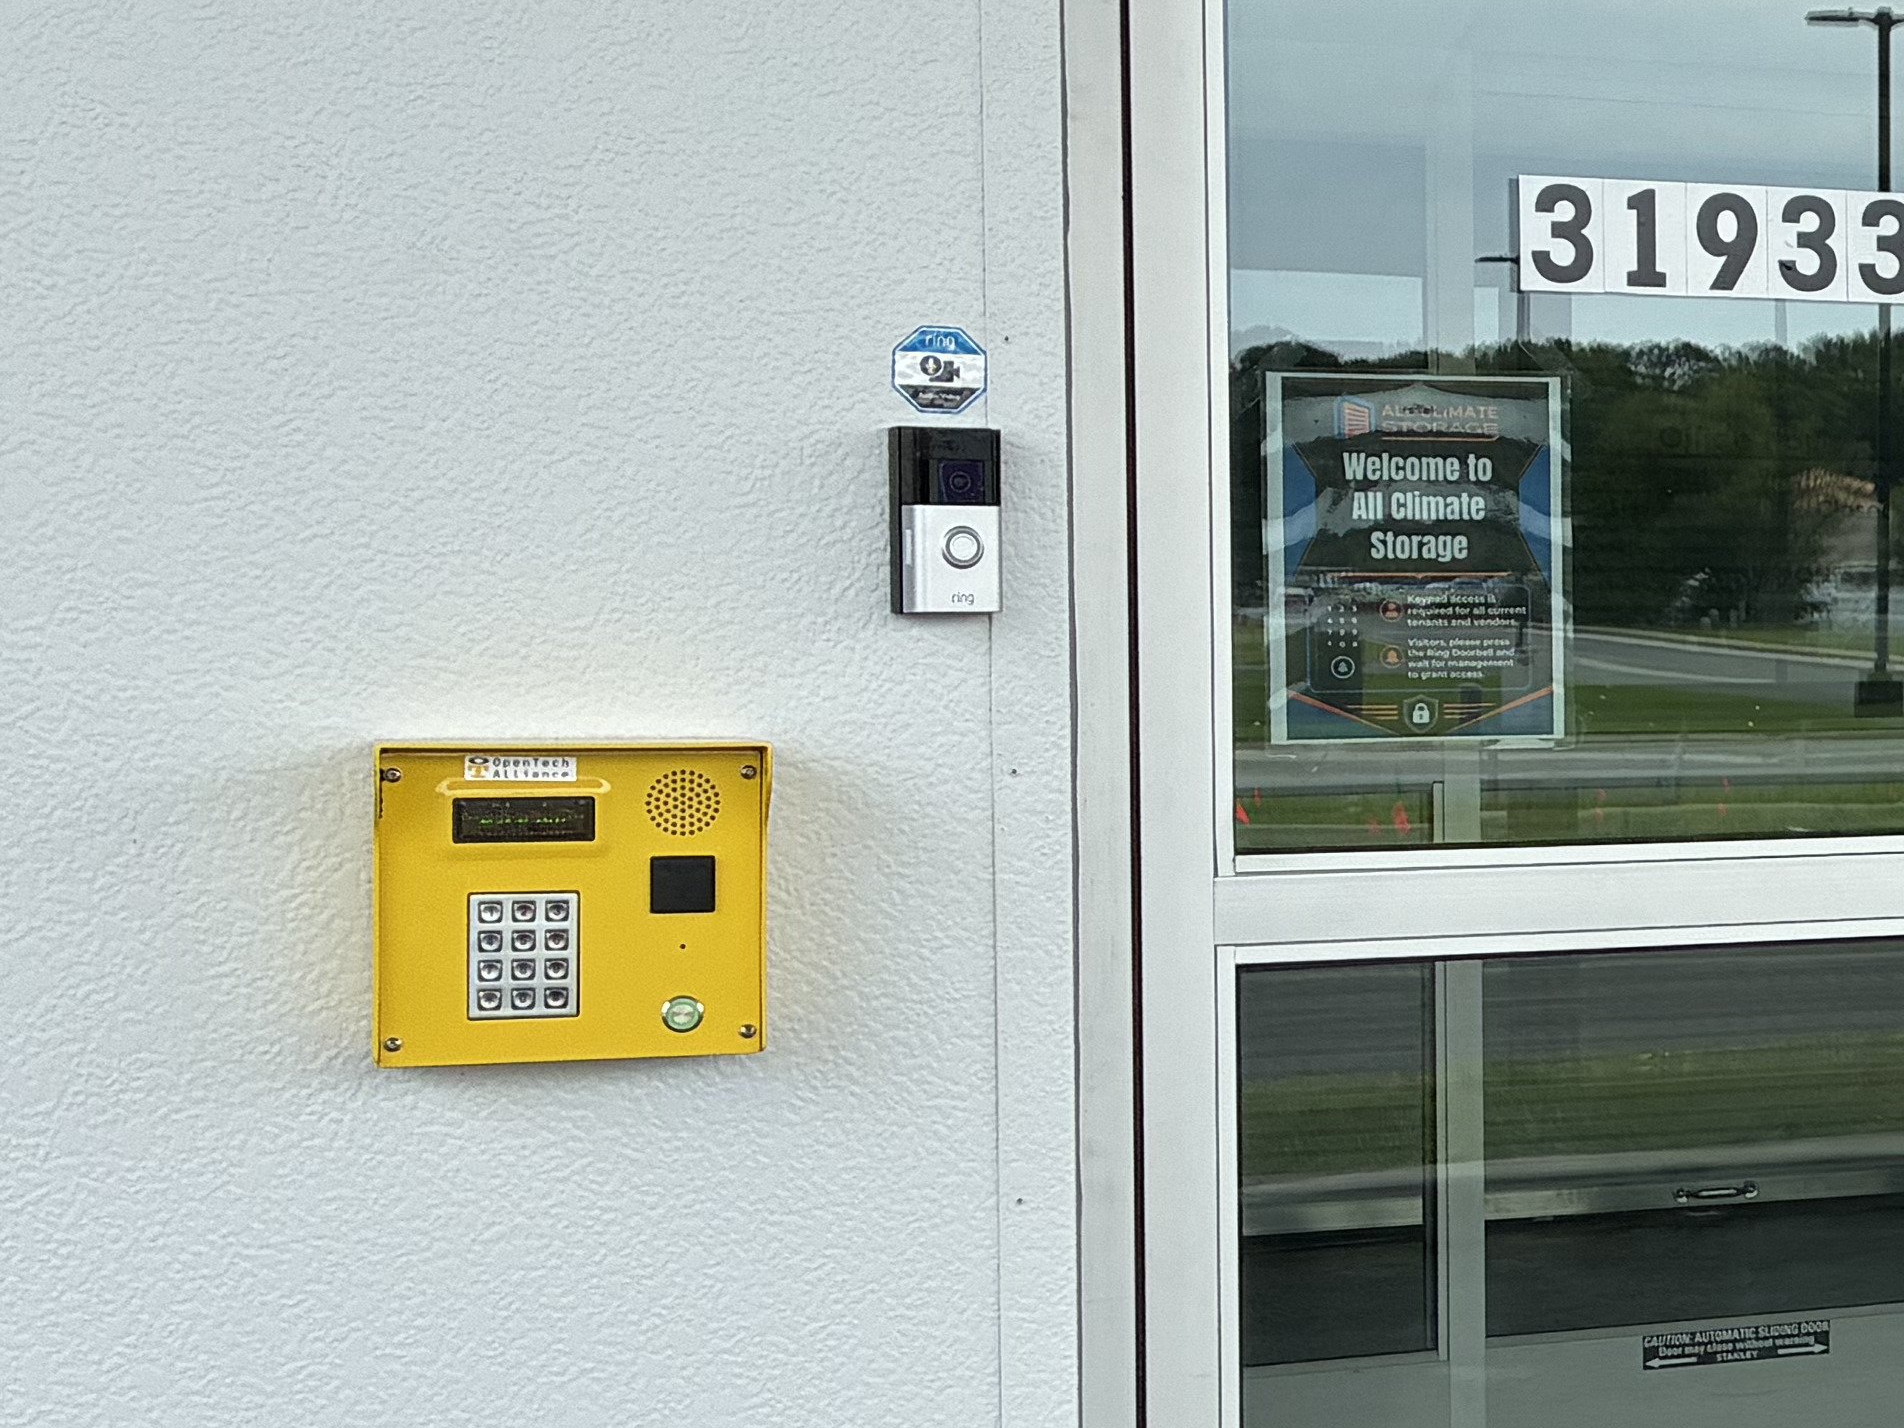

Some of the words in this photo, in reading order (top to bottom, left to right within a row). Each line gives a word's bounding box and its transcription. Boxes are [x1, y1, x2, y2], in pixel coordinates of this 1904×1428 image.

[925, 333, 956, 351] ring
[1381, 421, 1499, 434] STORAGE
[1342, 452, 1460, 481] Welcome
[1467, 453, 1493, 482] to
[1351, 491, 1384, 520] All
[1391, 490, 1486, 521] Climate
[1370, 530, 1468, 562] Storage
[951, 591, 975, 605] ring
[1407, 595, 1448, 605] Keypad
[1407, 606, 1453, 616] required
[1455, 606, 1470, 614] for
[1473, 606, 1486, 614] all
[1487, 606, 1527, 615] current
[1407, 618, 1449, 627] tenants
[1450, 618, 1471, 626] and
[1451, 648, 1494, 657] Doorbell
[1447, 659, 1514, 668] management
[492, 757, 570, 768] OpenTech
[492, 769, 569, 779] Alliance
[1695, 1327, 1756, 1344] AUTOMATIC
